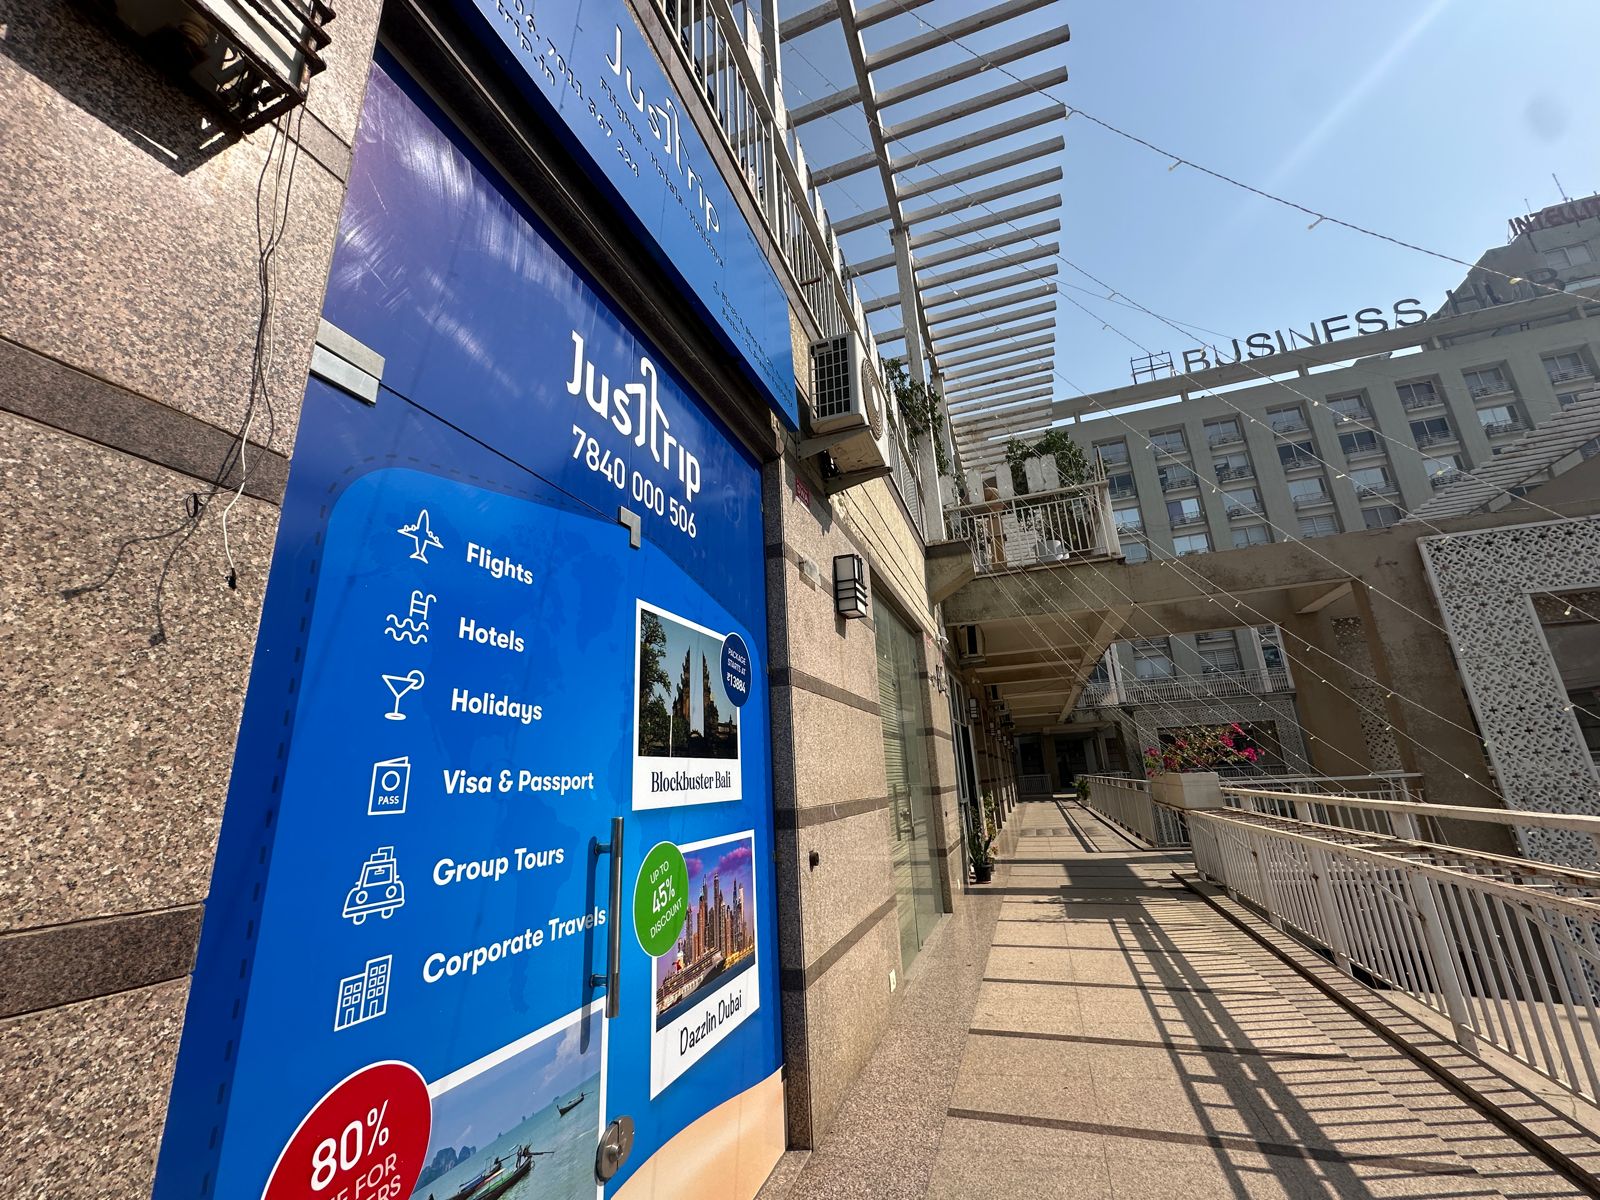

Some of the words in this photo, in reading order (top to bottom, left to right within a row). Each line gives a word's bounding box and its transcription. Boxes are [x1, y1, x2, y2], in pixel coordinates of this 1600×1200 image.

[547, 37, 584, 101] 7011
[587, 96, 614, 138] 367
[1182, 297, 1428, 375] BUSINESS
[572, 424, 626, 490] 7840
[632, 471, 665, 517] 000
[669, 496, 697, 539] 506
[466, 542, 534, 585] Flights
[458, 616, 525, 653] Hotels
[451, 688, 543, 725] Holidays
[377, 795, 400, 806] PASS
[443, 769, 492, 795] Visa
[498, 769, 514, 793] &
[518, 770, 595, 796] Passport
[651, 771, 715, 793] Blockbuster
[715, 770, 732, 789] Bali
[432, 856, 509, 886] Group
[514, 847, 565, 872] Tours
[650, 868, 660, 885] UP
[659, 860, 670, 877] TO
[651, 875, 676, 914] 45%
[650, 897, 683, 939] DISCOUNT
[422, 929, 544, 984] Corporate
[548, 906, 606, 942] Travels
[679, 1010, 717, 1057] Dazzlin
[718, 989, 743, 1023] Dubai
[310, 1099, 390, 1192] 80%
[355, 1152, 397, 1200] FOR
